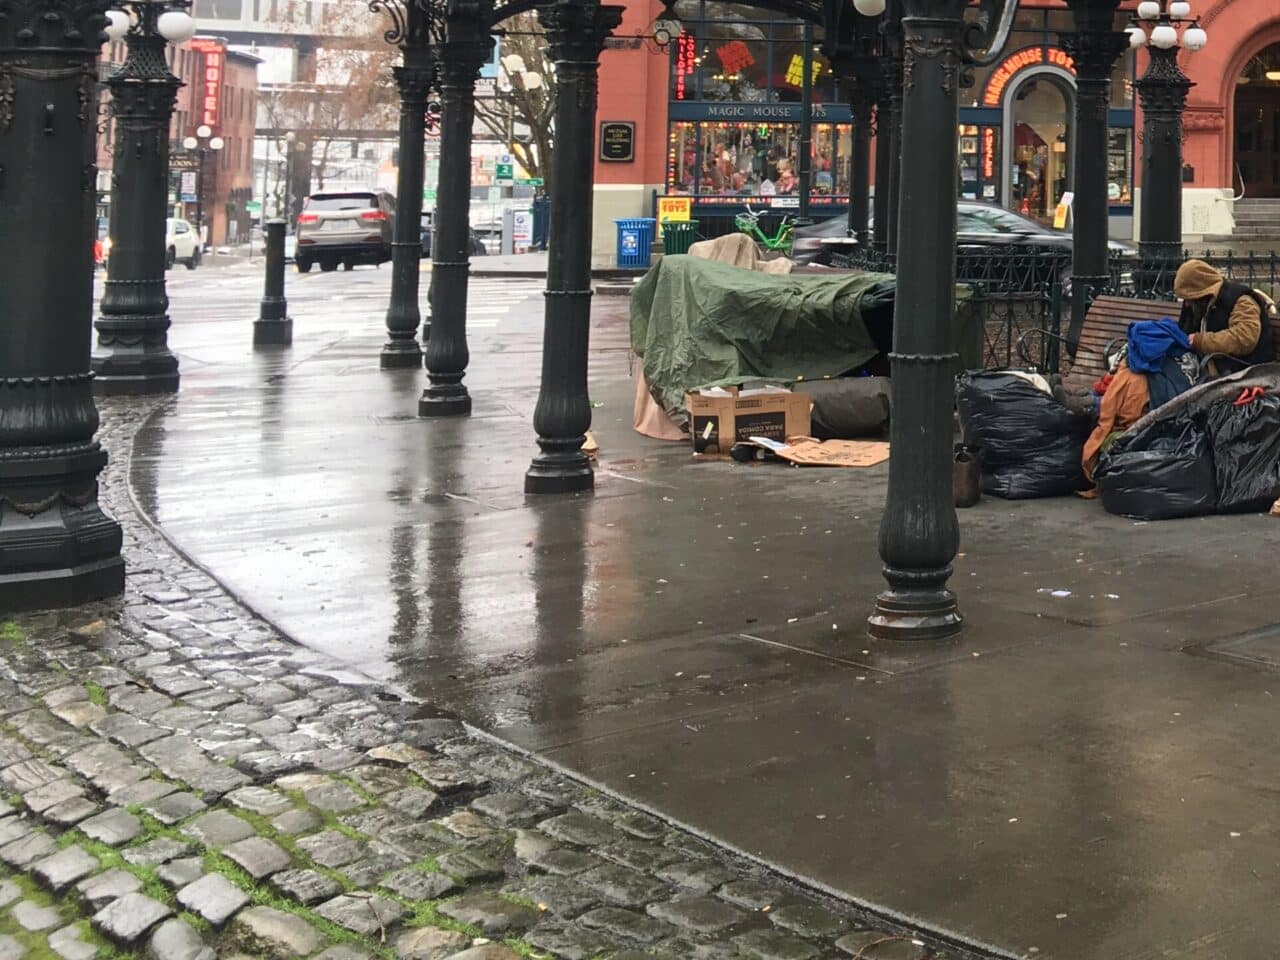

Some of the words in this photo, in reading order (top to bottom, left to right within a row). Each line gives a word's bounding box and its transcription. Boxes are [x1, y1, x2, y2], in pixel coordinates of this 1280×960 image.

[1003, 48, 1042, 72] MOUSE
[204, 53, 219, 125] HOTEL
[708, 105, 744, 115] MAGIC
[753, 107, 791, 117] MOUSE
[662, 204, 688, 213] TOYS
